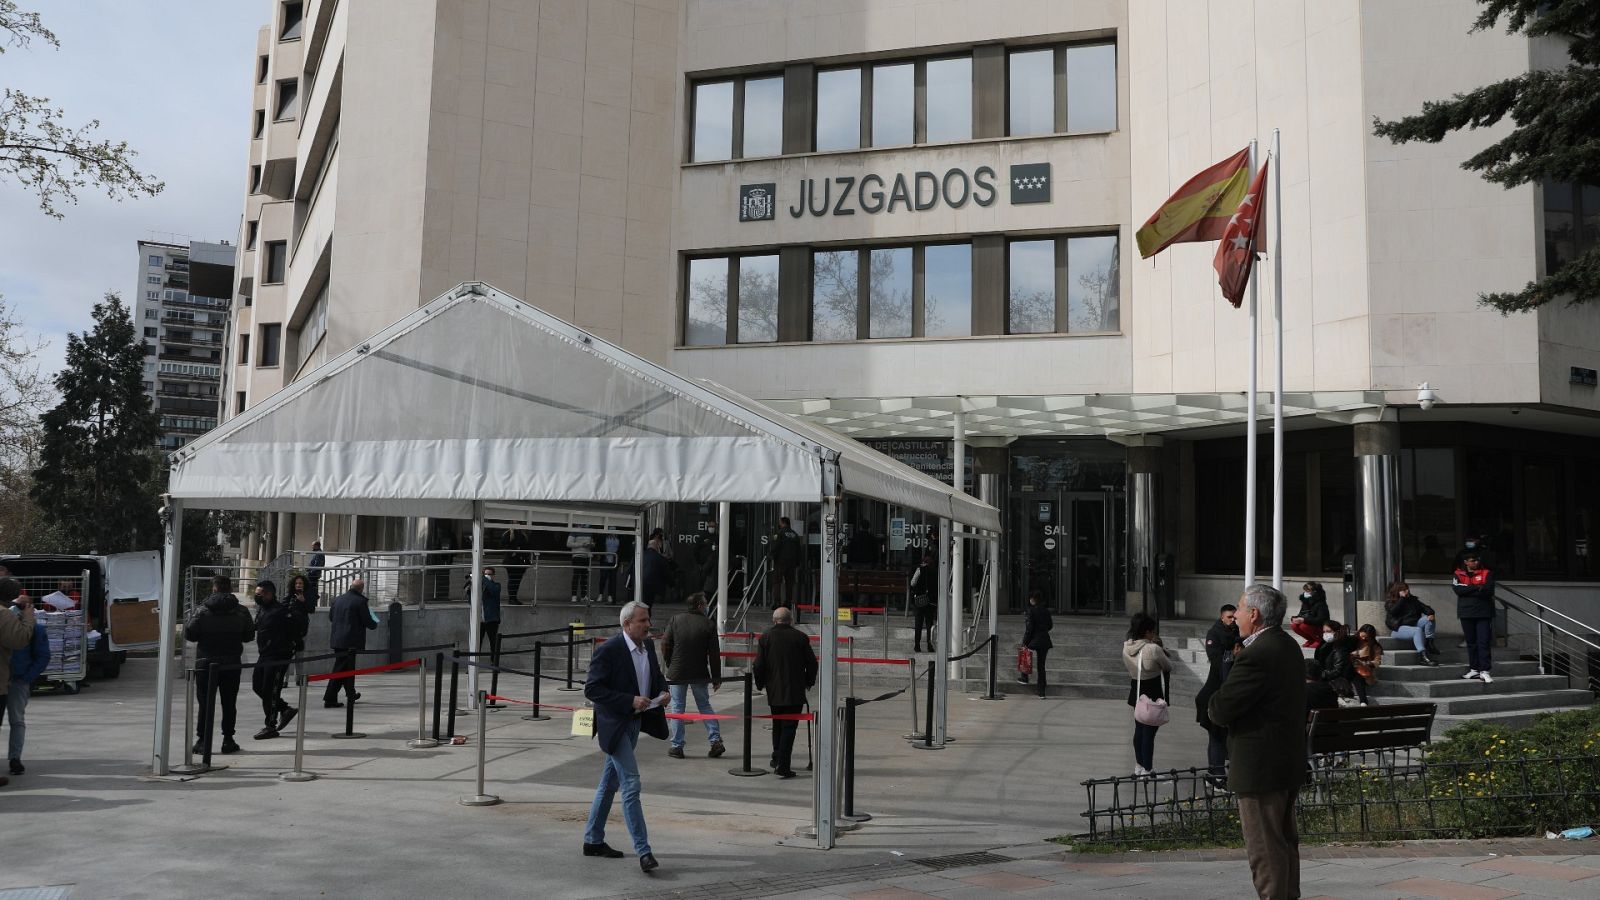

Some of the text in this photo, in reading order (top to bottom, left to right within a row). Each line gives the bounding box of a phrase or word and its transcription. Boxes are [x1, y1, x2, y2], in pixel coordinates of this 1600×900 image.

[789, 166, 996, 218] JUZGADOS
[875, 441, 888, 450] DE
[891, 441, 937, 450] CASTILLA
[1044, 524, 1068, 536] SAL
